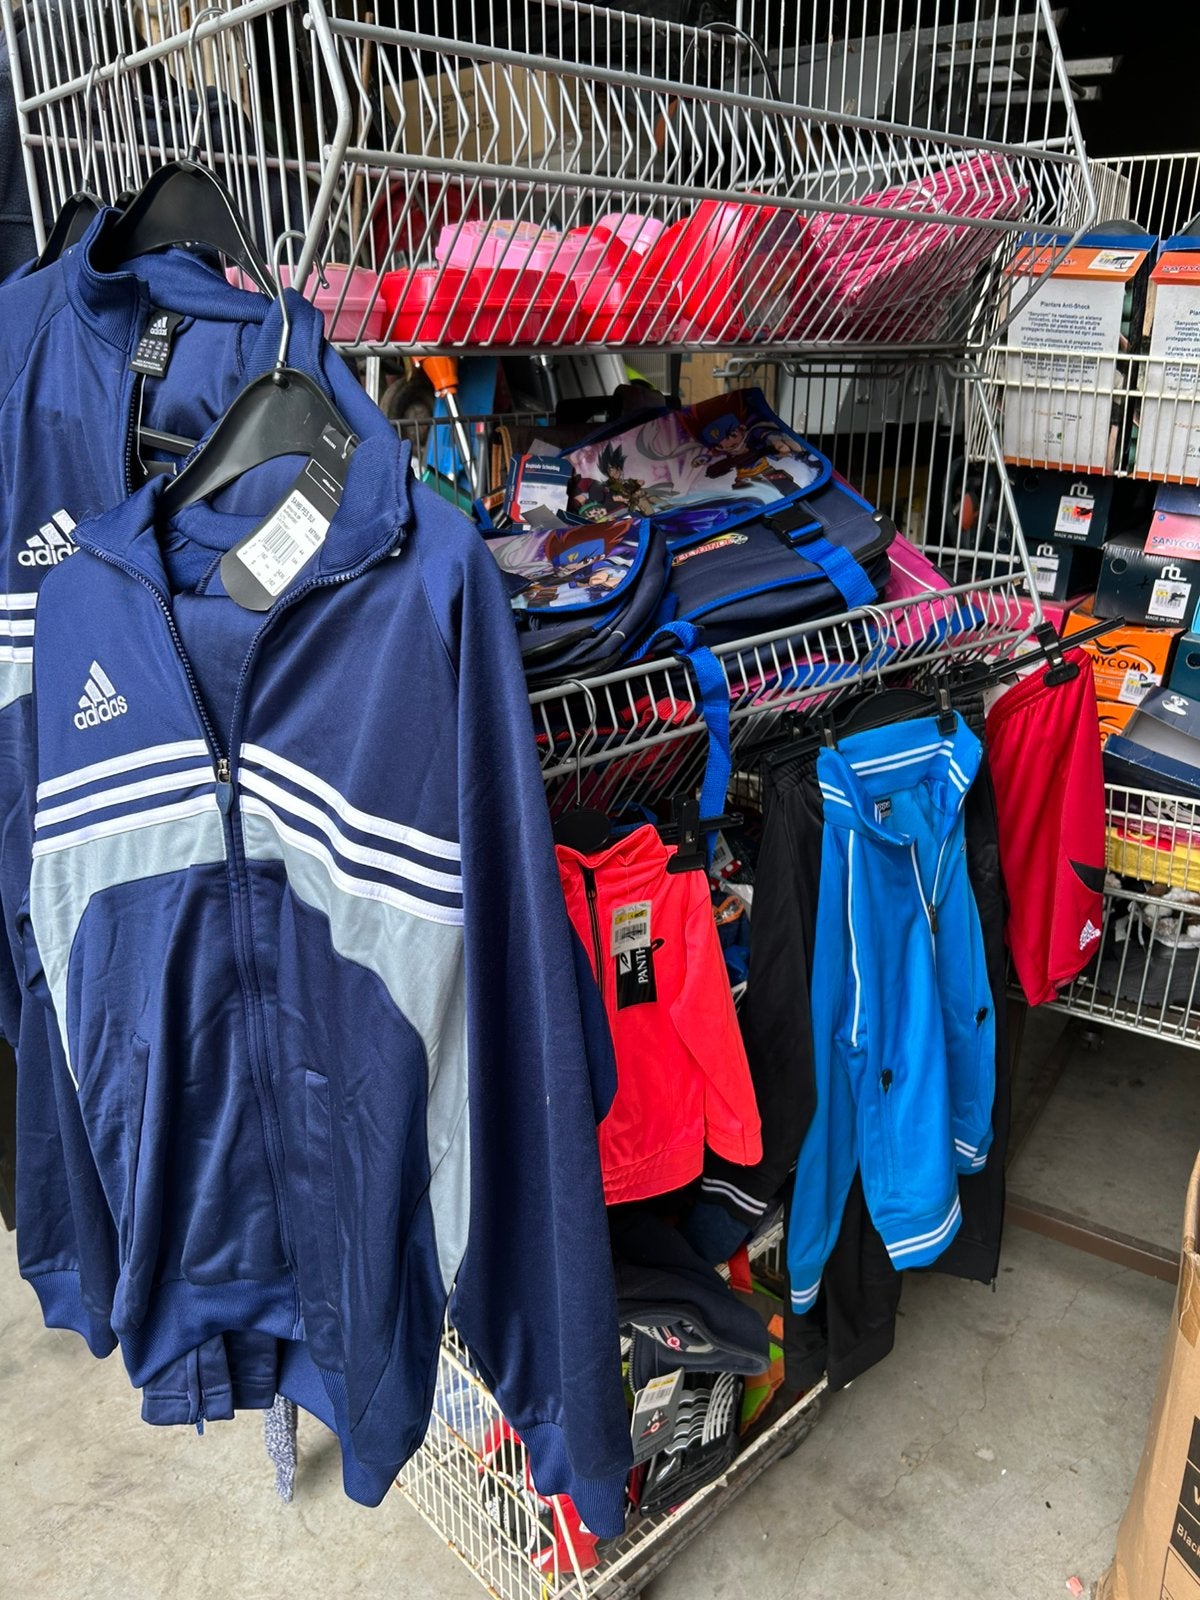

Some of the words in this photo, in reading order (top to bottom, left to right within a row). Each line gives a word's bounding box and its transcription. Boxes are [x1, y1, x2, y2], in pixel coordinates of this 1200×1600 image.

[17, 543, 81, 566] adid
[1091, 654, 1141, 671] NYCOM
[73, 694, 128, 730] adidas
